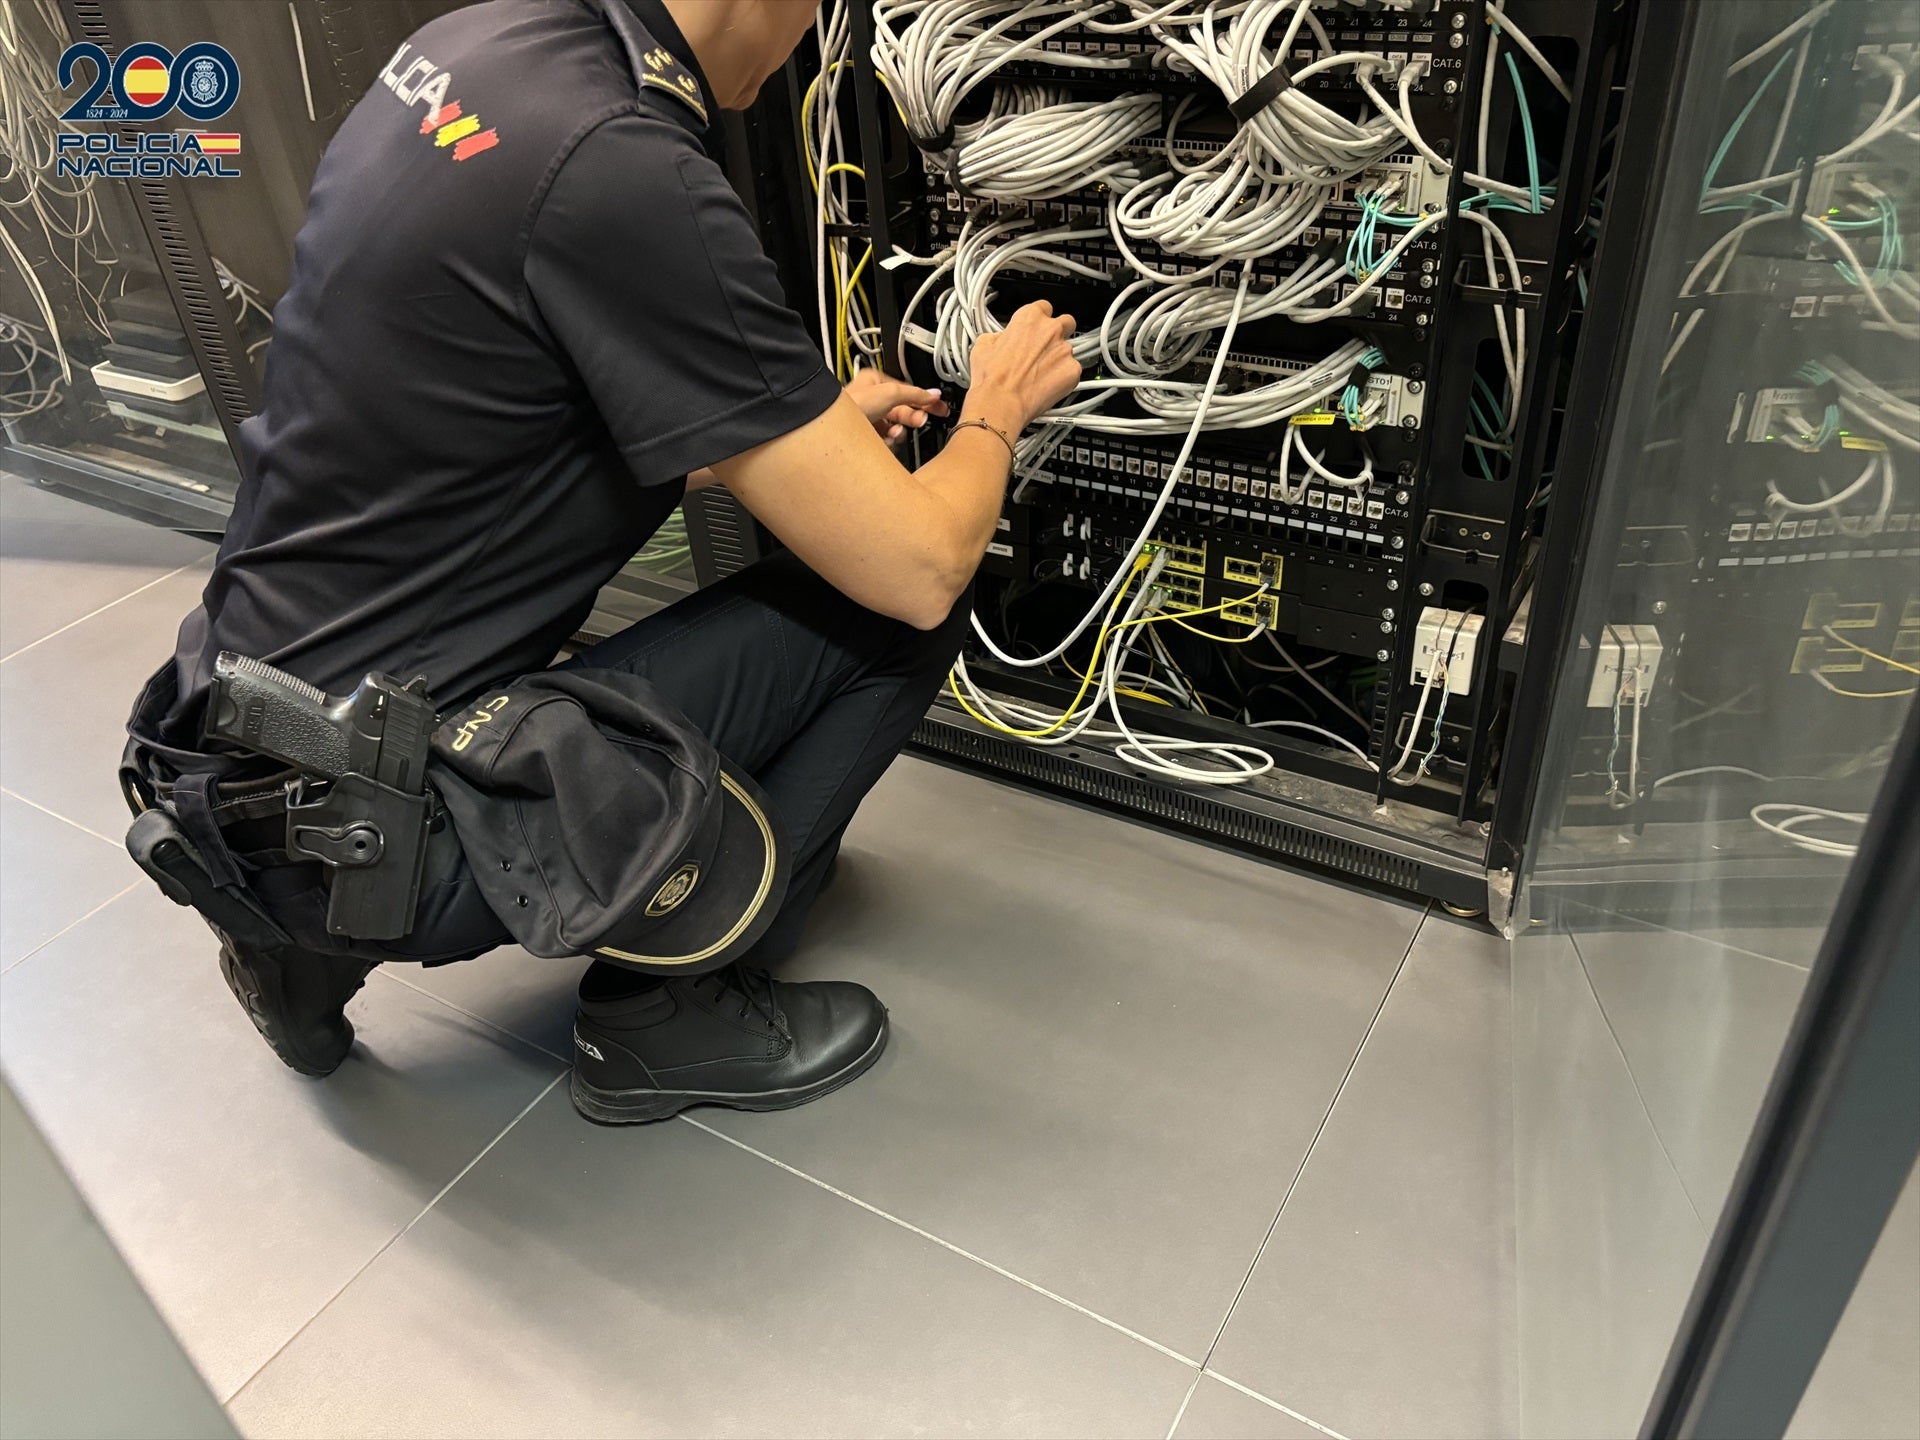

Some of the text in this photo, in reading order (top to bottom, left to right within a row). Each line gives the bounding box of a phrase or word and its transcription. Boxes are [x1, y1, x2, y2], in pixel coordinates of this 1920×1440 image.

[1326, 18, 1336, 26] 20
[1398, 18, 1408, 27] 23
[1422, 19, 1433, 28] 24
[1432, 58, 1462, 69] CAT.6
[1390, 83, 1399, 91] 23
[1413, 84, 1423, 92] 24
[1410, 240, 1437, 250] CAT.6
[1405, 295, 1431, 304] CAT.6
[1384, 507, 1409, 519] CAT.6
[451, 695, 509, 751] CNP
